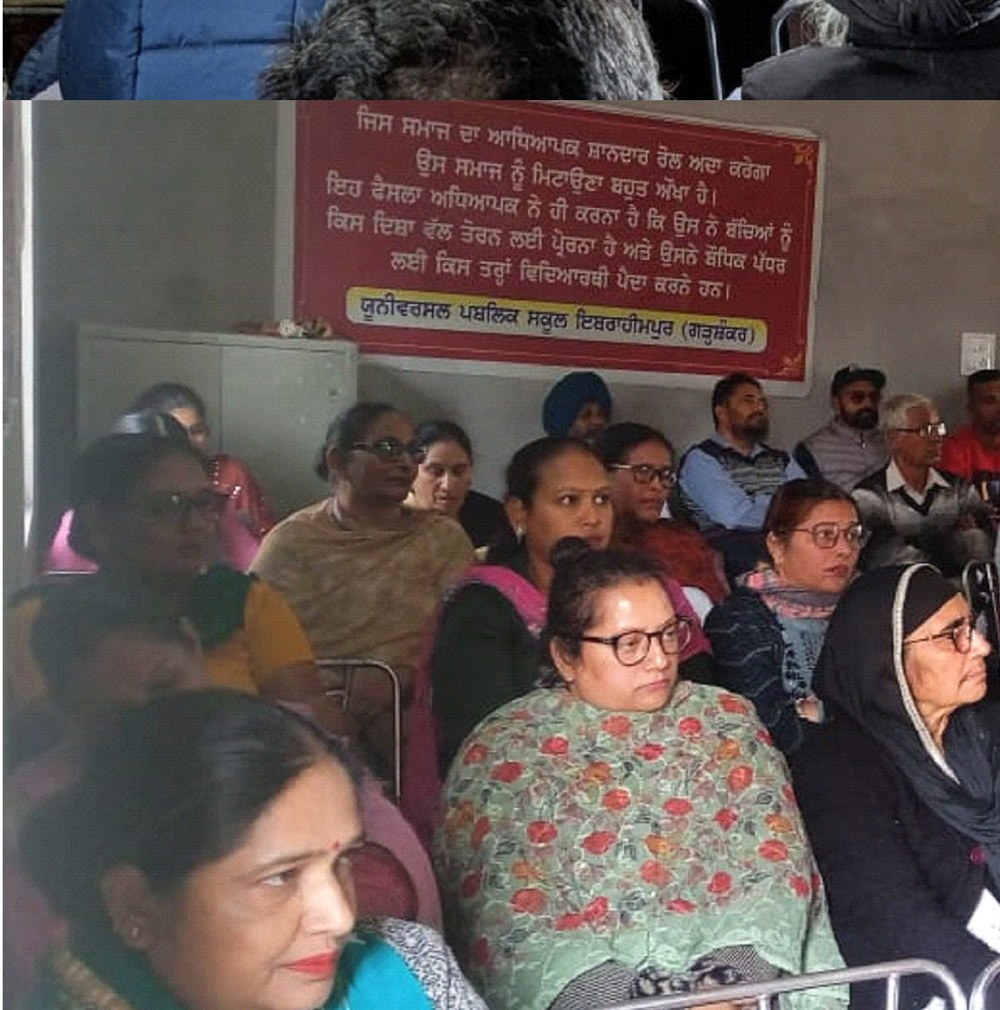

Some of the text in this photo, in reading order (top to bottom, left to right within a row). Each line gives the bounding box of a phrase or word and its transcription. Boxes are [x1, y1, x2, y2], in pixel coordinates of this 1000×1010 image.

[356, 104, 393, 132] ਜਿਸ
[402, 116, 450, 140] ਸਮਾਜ
[459, 125, 481, 142] ਦਾ
[689, 154, 723, 174] ਅਦਾ
[416, 148, 447, 177] ਉਸ
[455, 157, 503, 181] ਸਮਾਜ
[532, 162, 604, 194] ਮਿਟਾਉਣਾ
[611, 177, 649, 201] ਬਹੁਤ
[326, 170, 363, 198] ਇਹ
[550, 197, 569, 221] ਹੀ
[575, 206, 620, 226] ਕਰਨਾ
[647, 208, 666, 232] ਕਿ
[674, 210, 699, 237] ਉਸ
[327, 205, 363, 233] ਕਿਸ
[509, 227, 545, 250] ਲਈ
[390, 248, 428, 272] ਲਈ
[435, 250, 472, 276] ਕਿਸ
[360, 292, 451, 322] ਯੂਨੀਵਰਸਲ
[459, 302, 519, 325] ਪਬਲਿਕ
